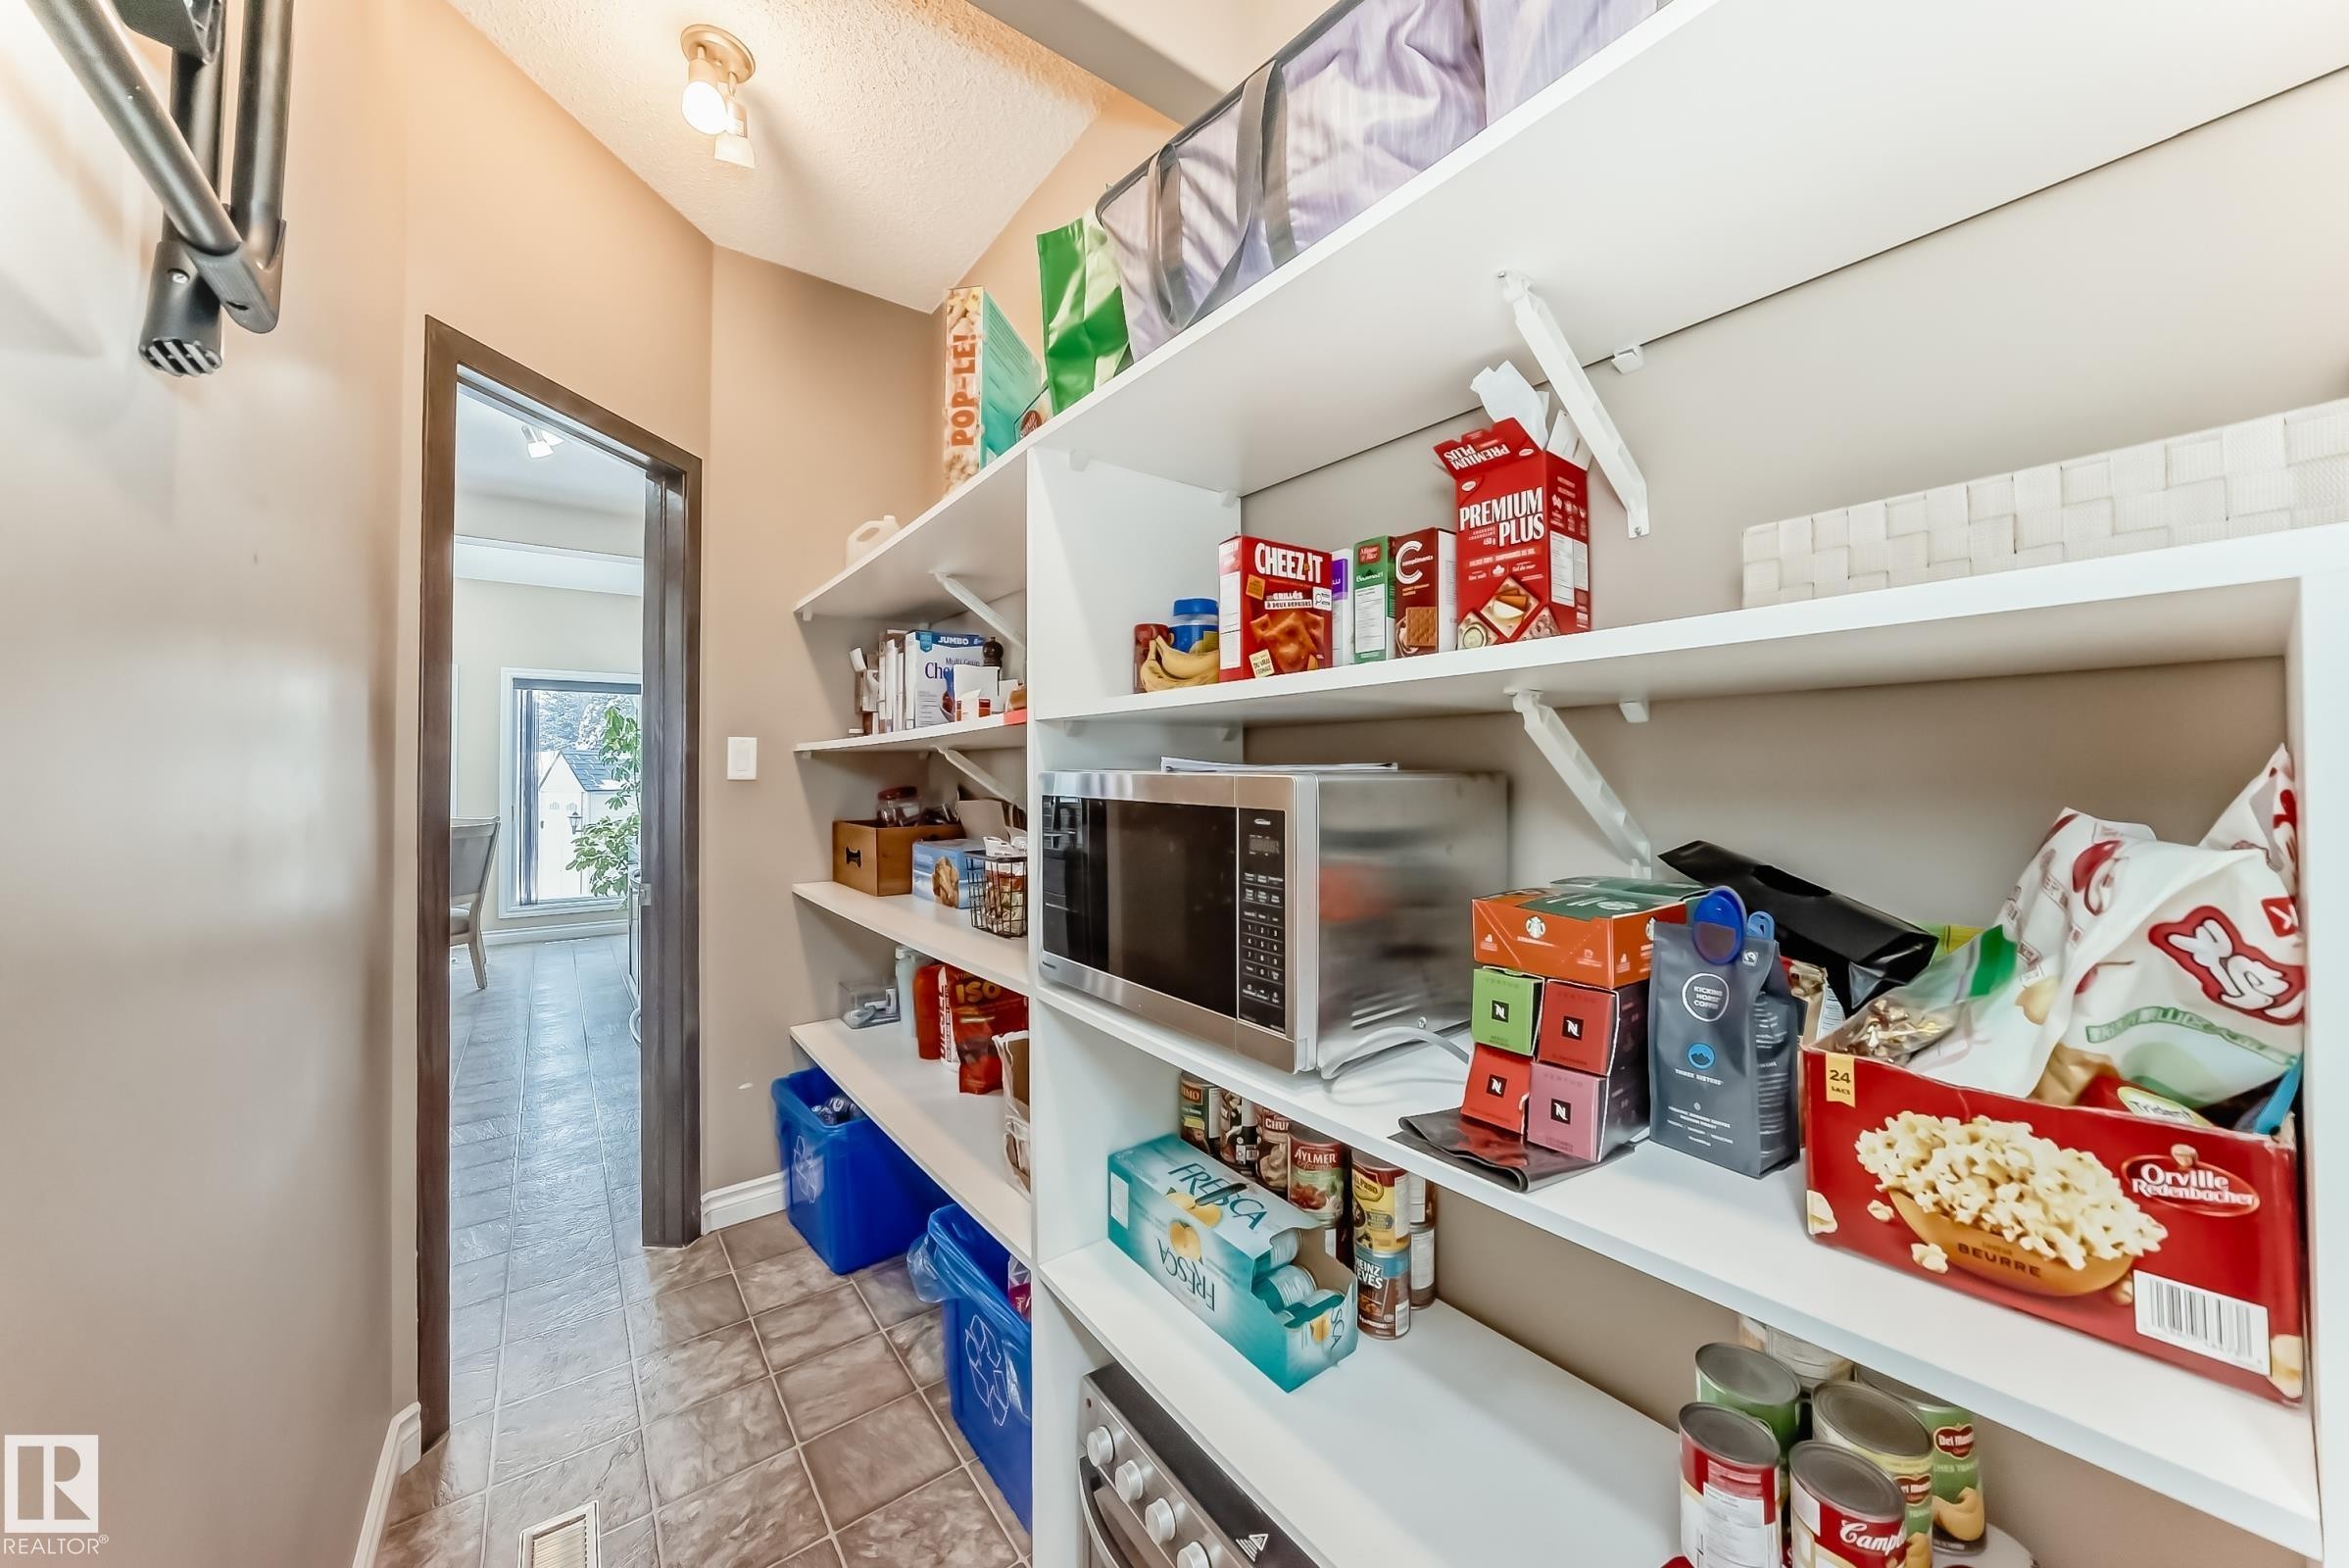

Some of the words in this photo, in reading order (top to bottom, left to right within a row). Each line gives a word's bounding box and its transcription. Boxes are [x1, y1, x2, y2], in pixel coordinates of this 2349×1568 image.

[950, 334, 977, 447] POP-LE!
[1444, 444, 1476, 461] PLUS
[1451, 444, 1510, 470] PREMIUM
[1459, 487, 1542, 531] PREMIUM
[1499, 514, 1544, 547] PLUS
[938, 636, 969, 646] JUMBO
[955, 981, 1002, 1004] ISO
[1830, 1069, 1851, 1083] 24
[1295, 1148, 1336, 1163] AYLMER
[2140, 1163, 2228, 1190] Orville
[2131, 1178, 2254, 1205] Redenbacher
[1958, 1243, 2041, 1278] BEURRE
[1156, 1239, 1215, 1311] FRESCA
[1356, 1270, 1384, 1290] EVES
